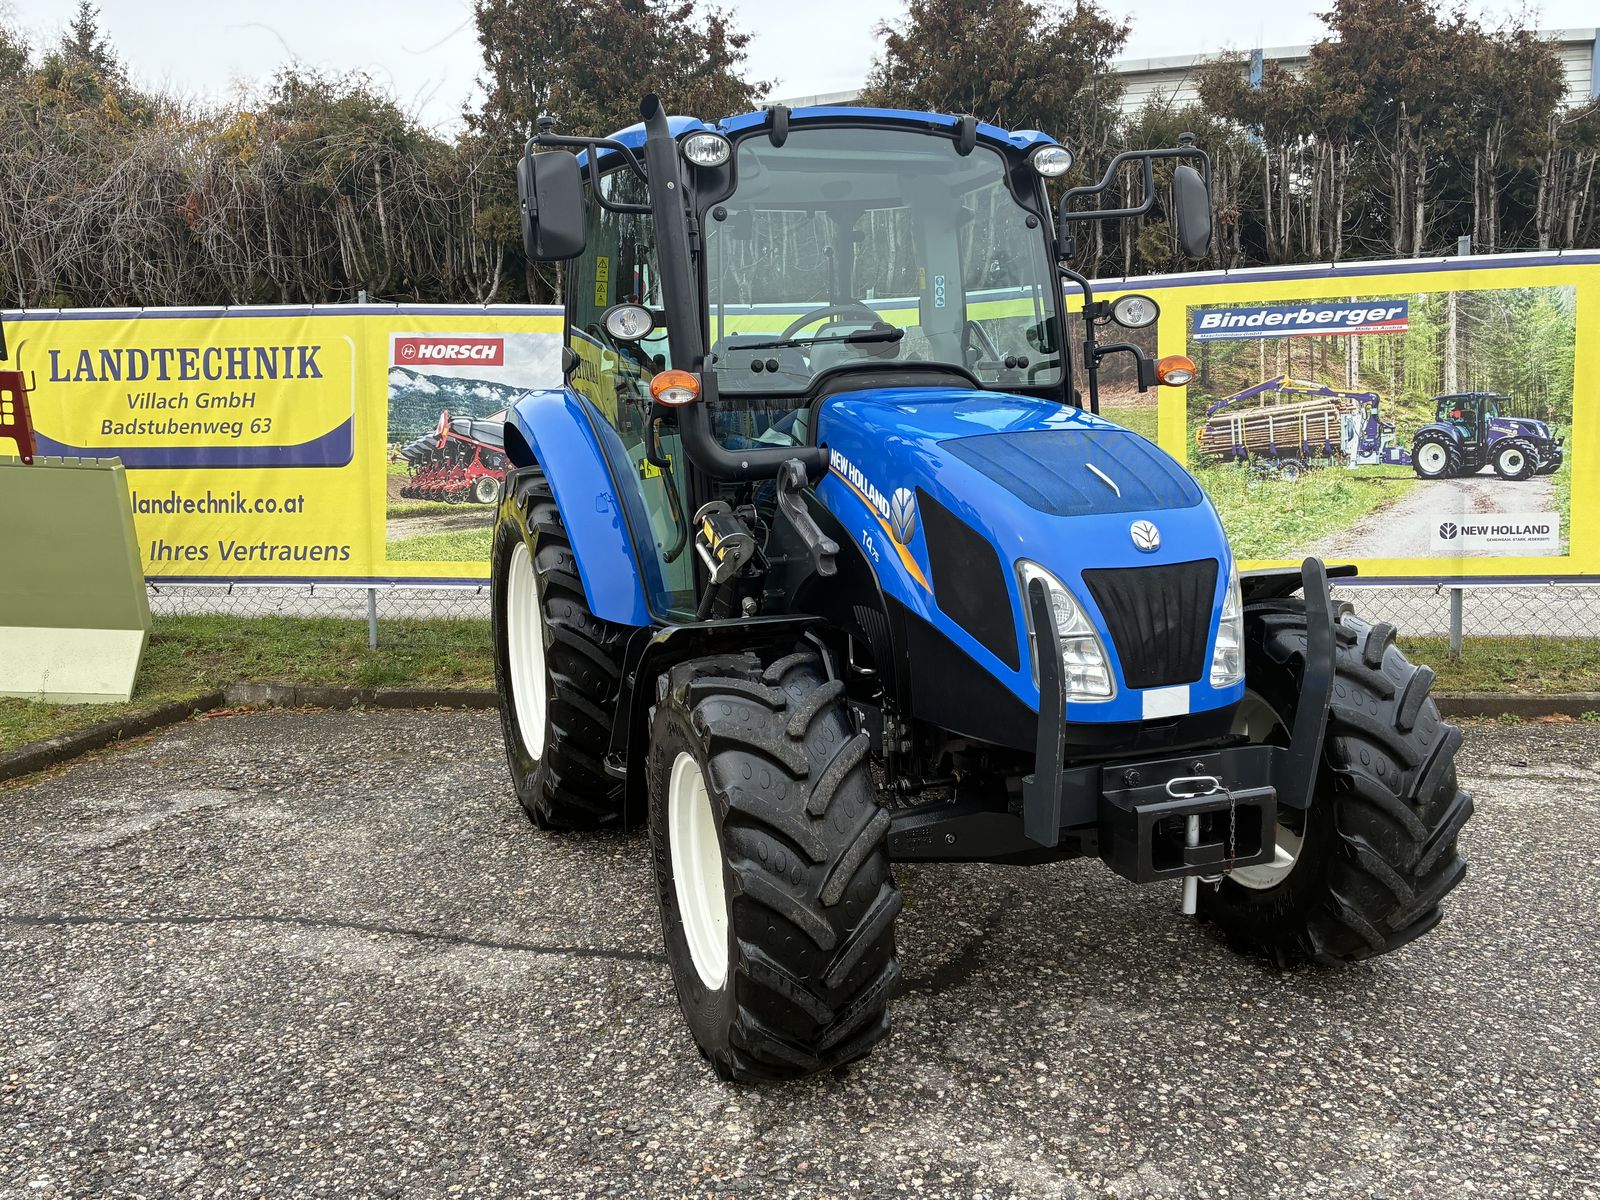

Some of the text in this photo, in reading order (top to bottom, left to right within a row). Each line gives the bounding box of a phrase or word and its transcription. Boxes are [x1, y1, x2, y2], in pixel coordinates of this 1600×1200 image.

[1199, 307, 1403, 328] Binderberger
[418, 344, 498, 359] HORSCH
[48, 345, 323, 382] LANDTECHNIK
[127, 391, 256, 410] Villach GmbH
[101, 417, 272, 439] Badstubenweg 63
[830, 447, 890, 520] NEW HOLLAND
[132, 490, 304, 514] landtechnik.co.at
[1461, 525, 1550, 536] NEW HOLLAND
[150, 539, 351, 562] Ihres Vertrauens
